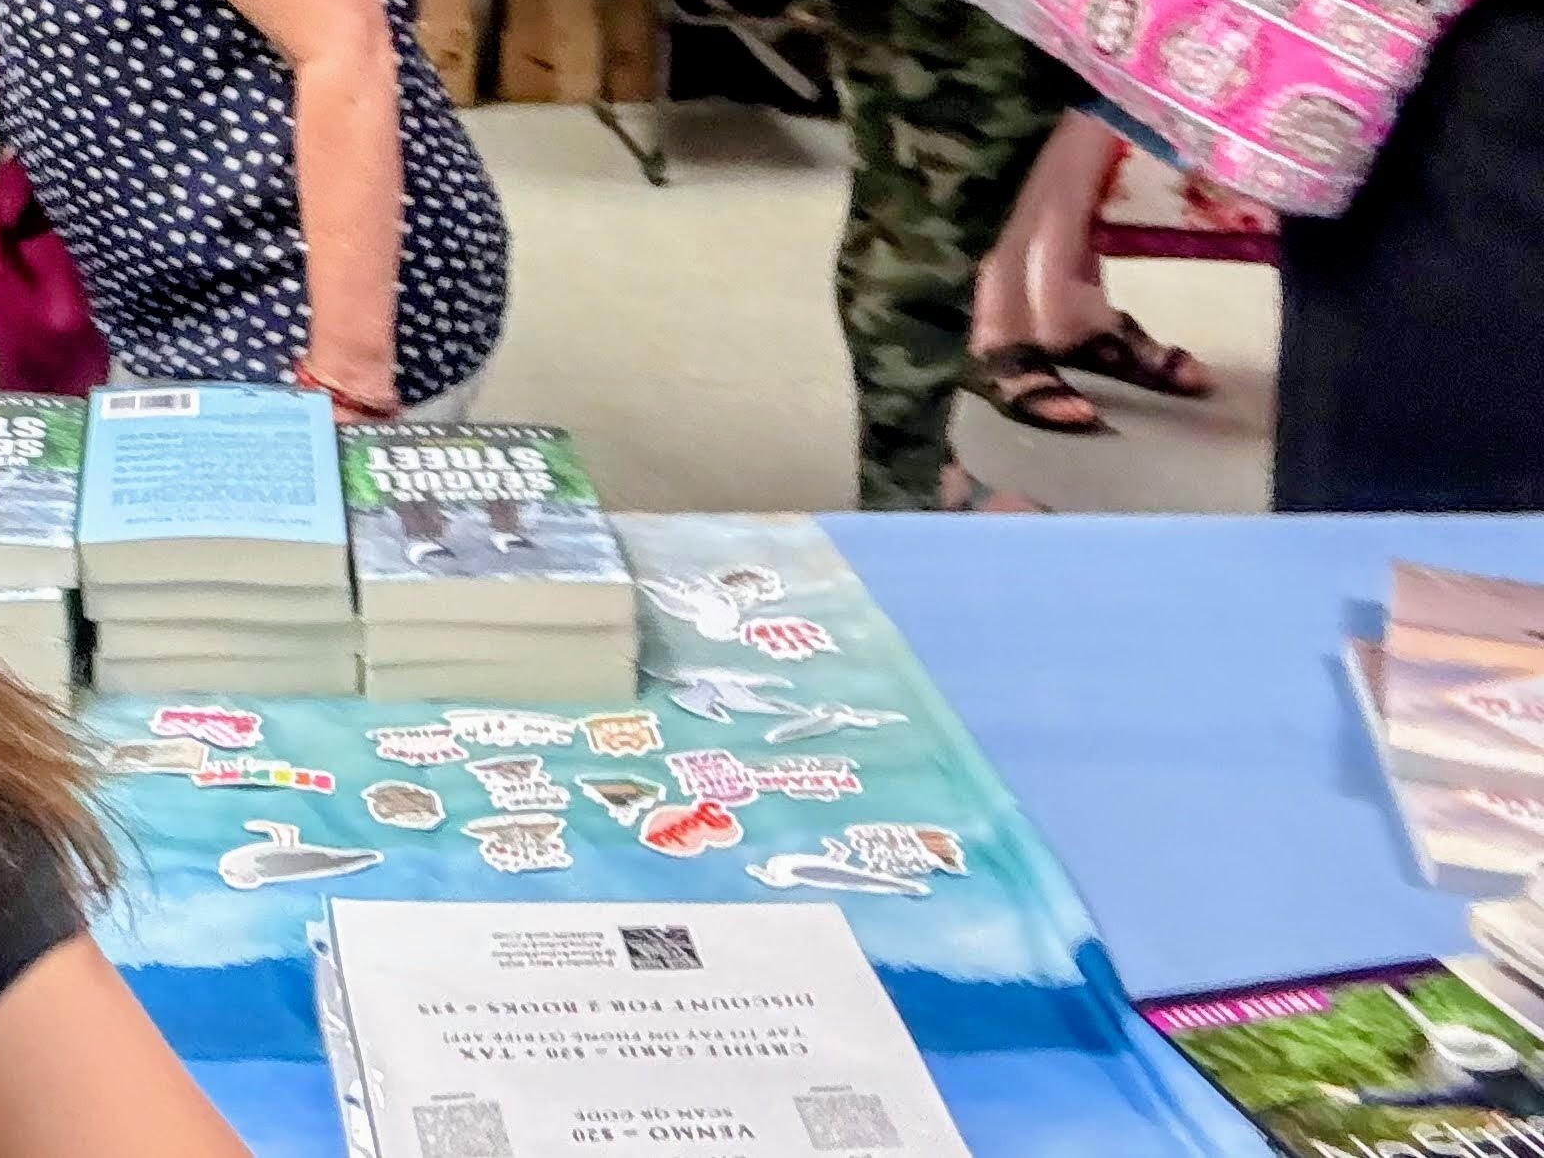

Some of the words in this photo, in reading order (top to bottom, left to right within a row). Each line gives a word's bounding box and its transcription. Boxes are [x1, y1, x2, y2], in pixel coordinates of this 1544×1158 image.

[364, 445, 548, 472] STREET
[367, 469, 556, 492] SEAGULL
[392, 490, 426, 503] TO
[432, 489, 545, 502] WELCOME
[487, 1001, 578, 1015] BOOKS
[610, 999, 662, 1013] FOR
[673, 993, 815, 1012] DISCOUNT
[571, 1031, 642, 1042] PHONE
[647, 1030, 679, 1041] ON
[687, 1029, 723, 1041] PAY
[729, 1029, 756, 1041] TO
[765, 1026, 806, 1040] TAP
[457, 1046, 515, 1061] TAX
[616, 1044, 693, 1059] CARD
[705, 1042, 808, 1059] CREDIT
[573, 1109, 634, 1123] CODE
[640, 1106, 670, 1122] QR
[676, 1108, 733, 1121] SCAN
[571, 1126, 613, 1143] $20
[648, 1125, 755, 1142] VENMO
